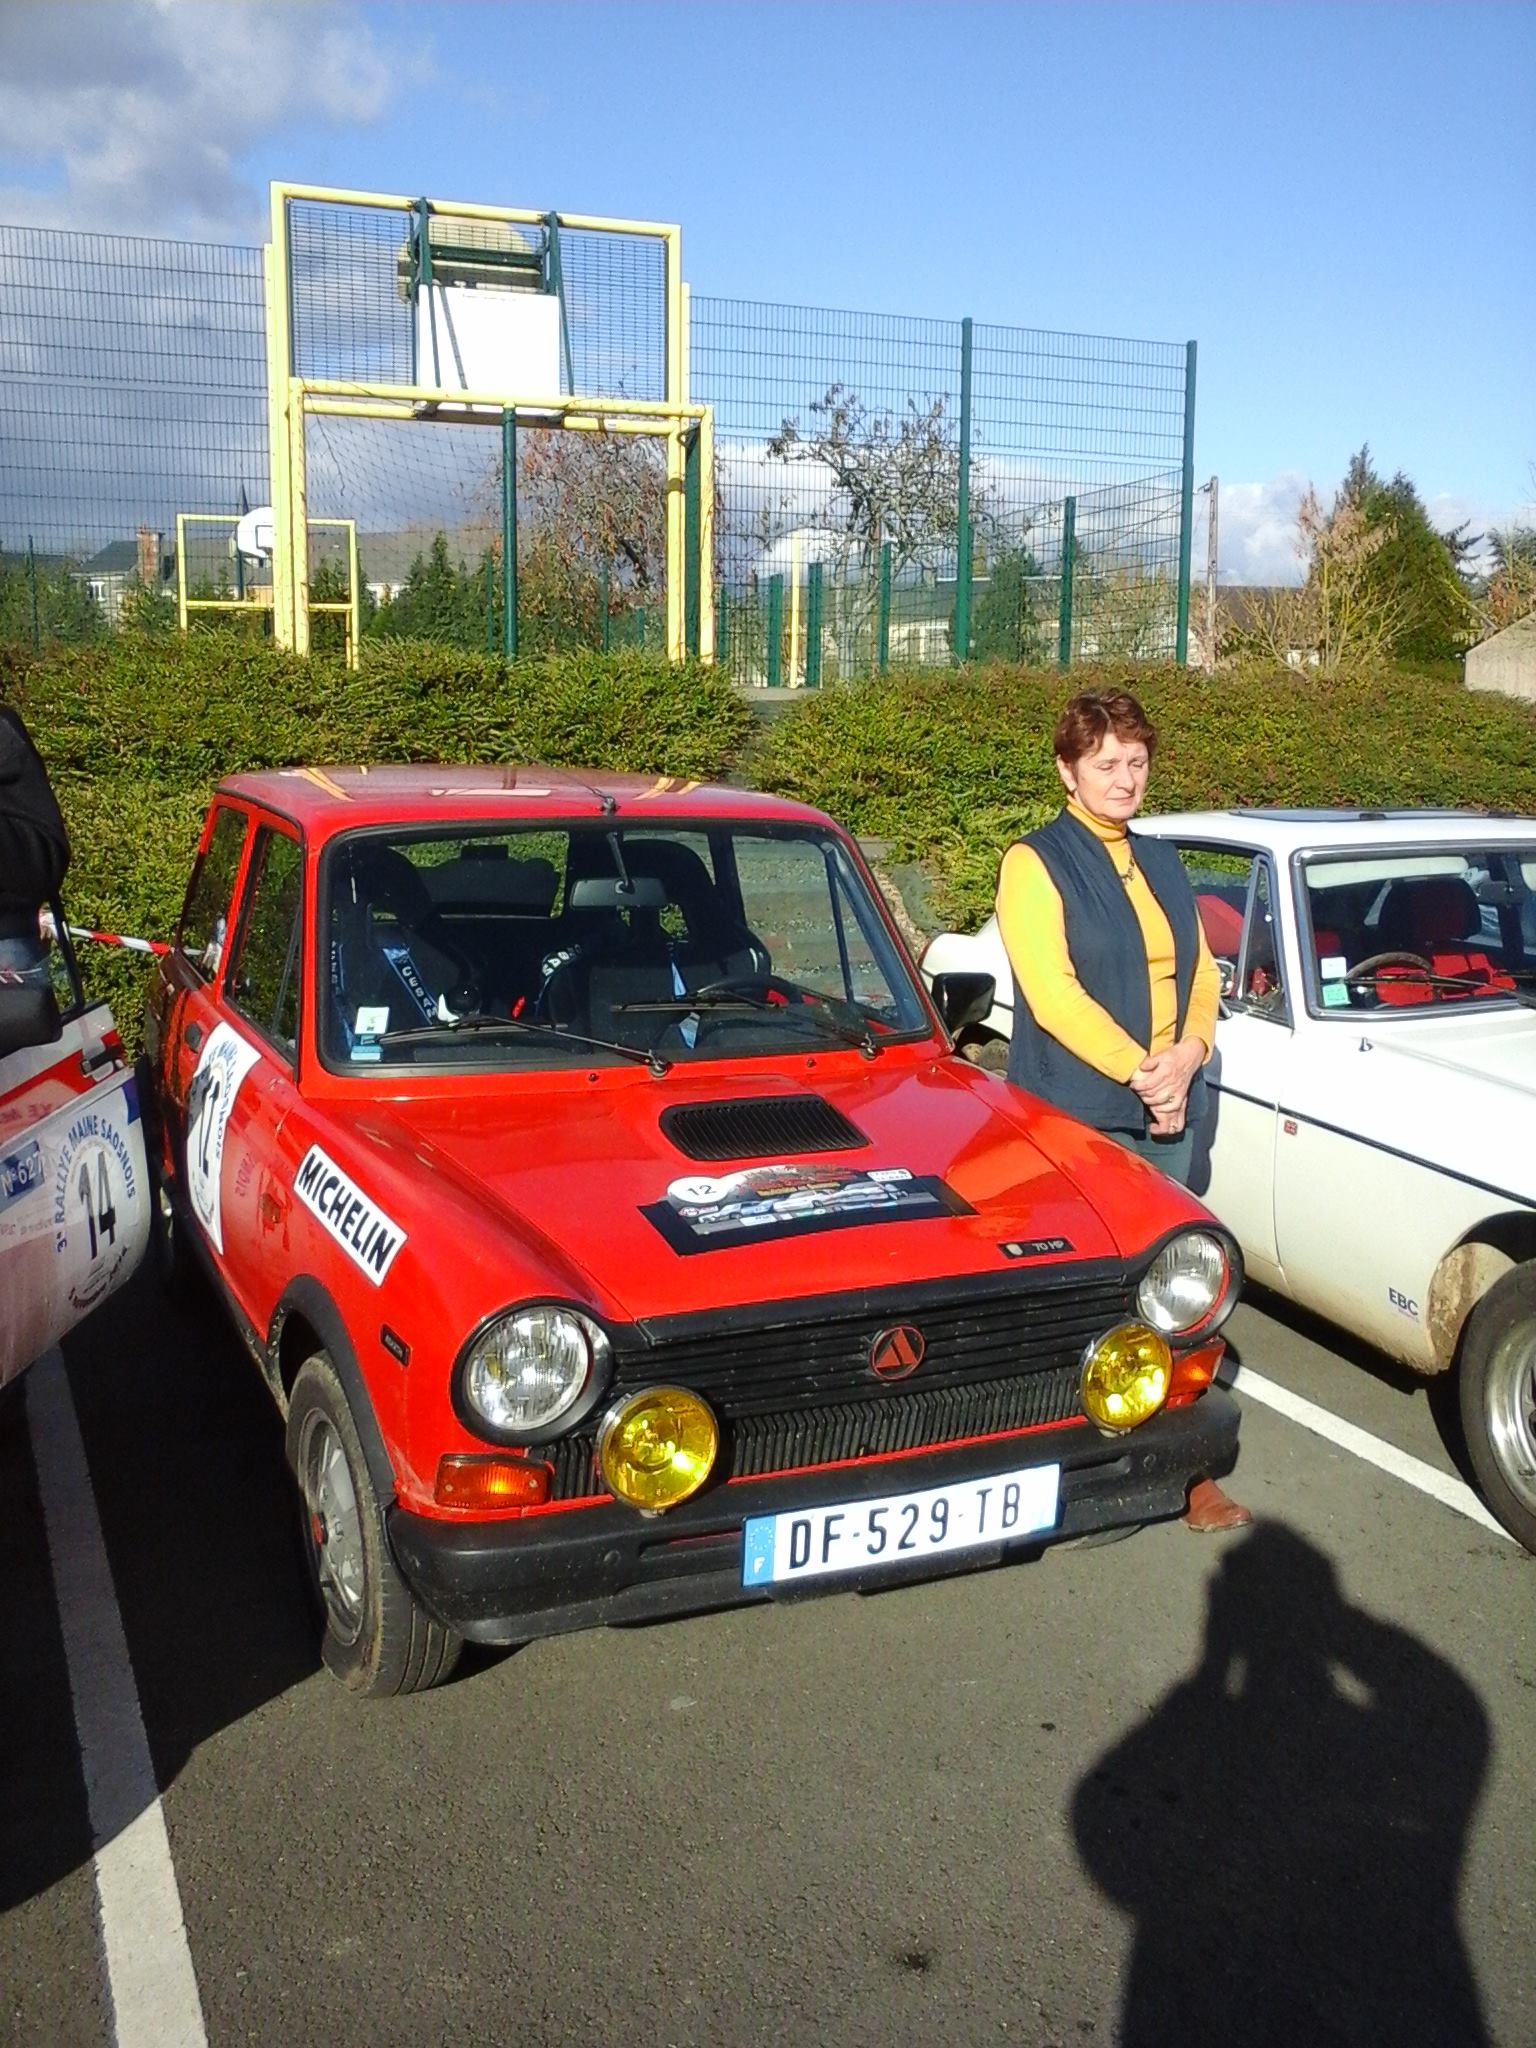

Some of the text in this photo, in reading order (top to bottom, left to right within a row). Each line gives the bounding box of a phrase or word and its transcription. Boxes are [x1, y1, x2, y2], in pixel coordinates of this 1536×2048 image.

[55, 1144, 73, 1223] RALLYE
[68, 1114, 98, 1151] MAINE
[100, 1118, 136, 1199] SAOSNOIS
[688, 1184, 717, 1196] 12
[78, 1150, 116, 1260] 14
[299, 1152, 396, 1274] MICHELIN
[1031, 1242, 1049, 1252] 70
[1389, 1287, 1418, 1316] EBC
[789, 1482, 1021, 1569] DF-529-TB
[753, 1556, 765, 1575] F
